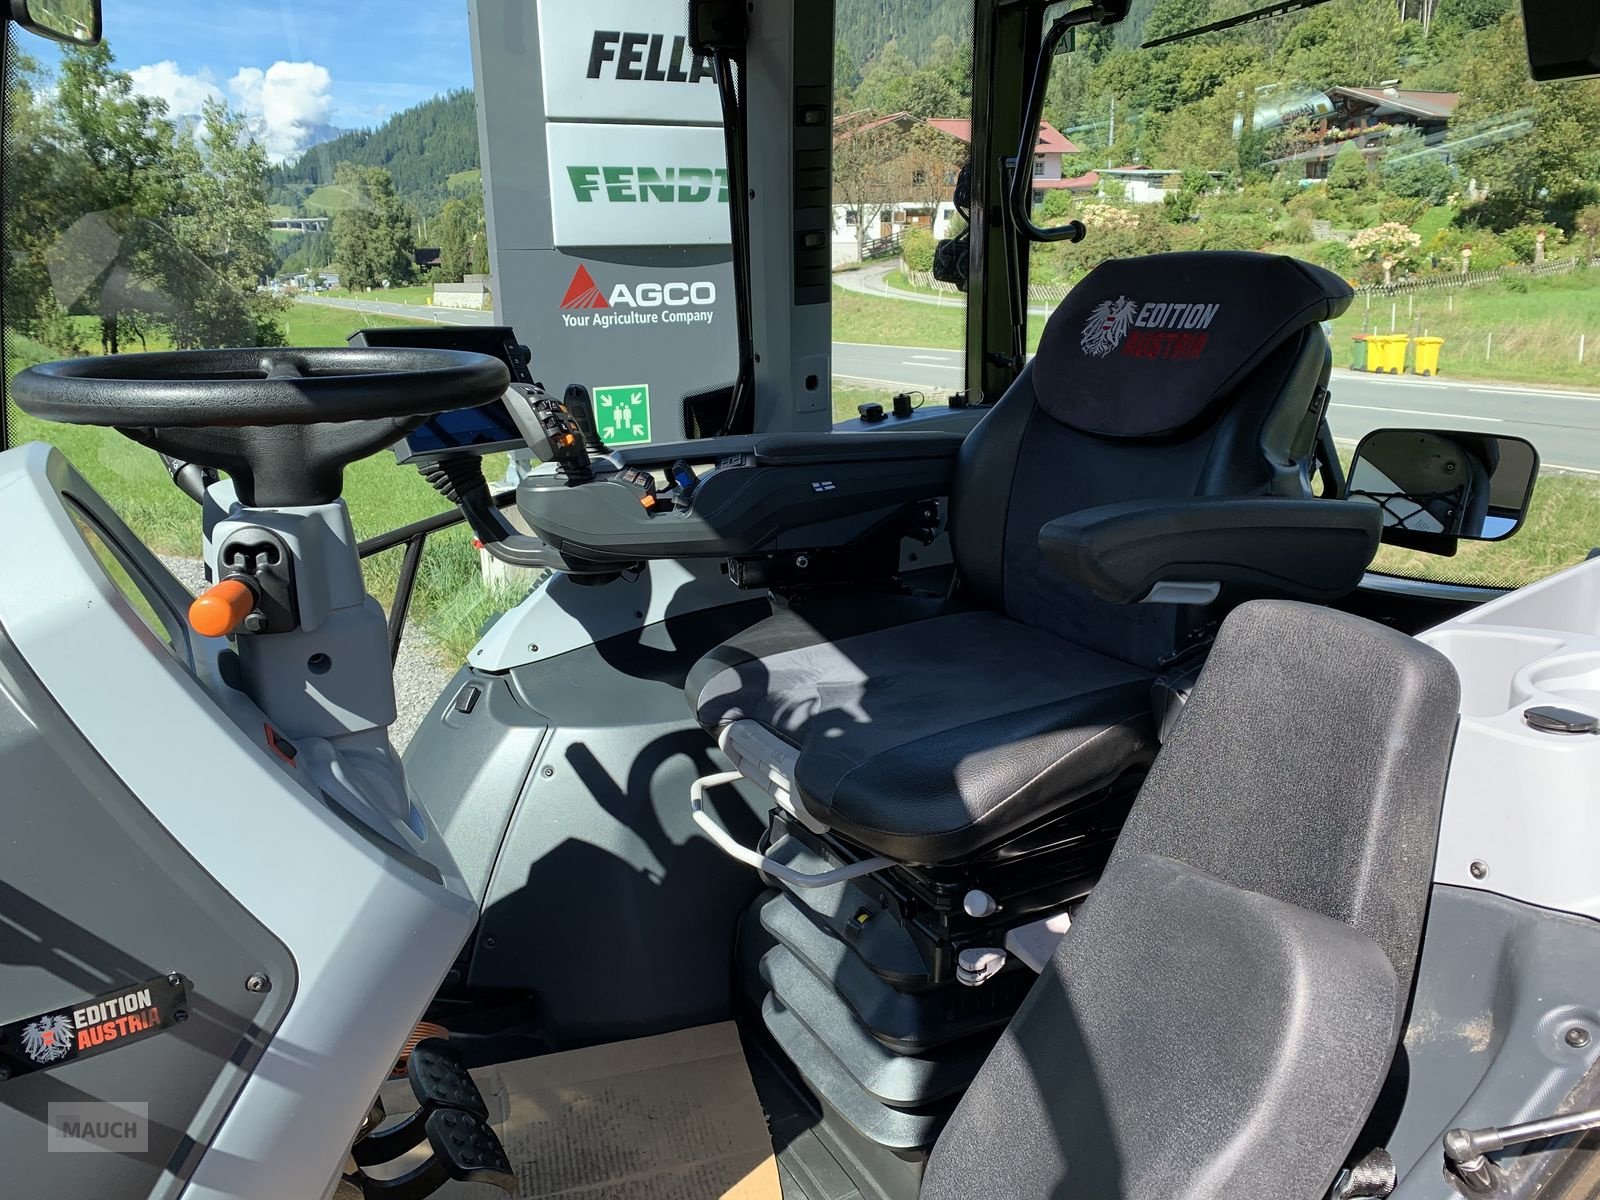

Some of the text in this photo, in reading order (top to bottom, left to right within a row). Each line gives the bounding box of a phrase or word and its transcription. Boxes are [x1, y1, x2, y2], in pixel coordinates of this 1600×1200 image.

[608, 281, 716, 308] AGCO
[562, 310, 713, 328] Your Agriculture Company
[1135, 303, 1220, 329] EDITION
[1120, 332, 1209, 360] AUSTRIA
[73, 988, 152, 1029] EDITION
[78, 1007, 161, 1050] AUSTRIA
